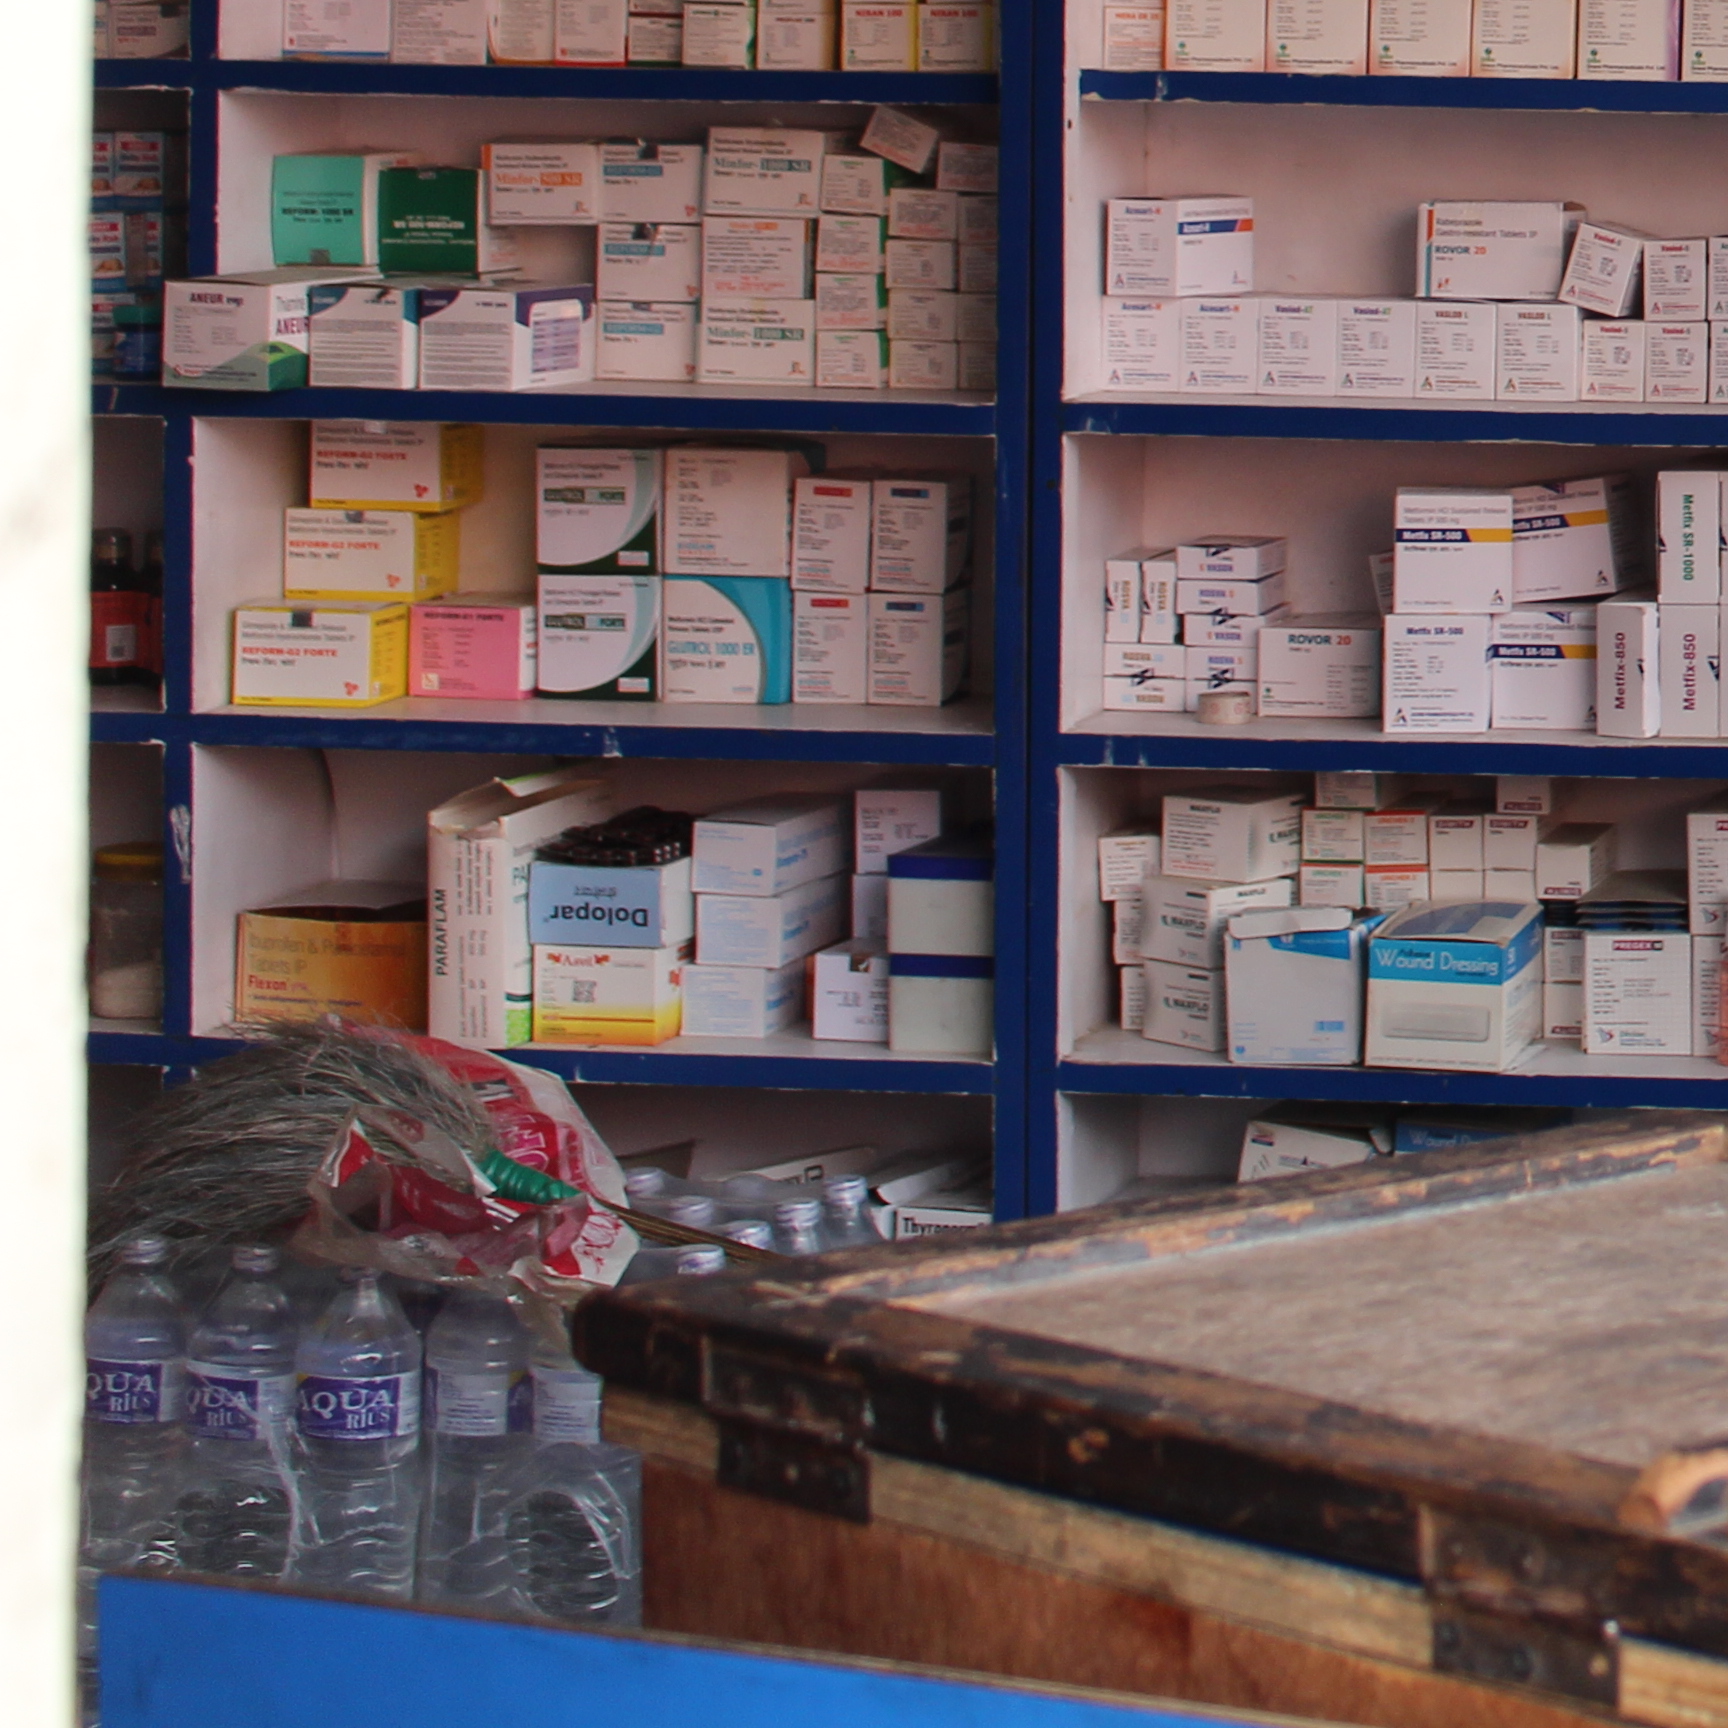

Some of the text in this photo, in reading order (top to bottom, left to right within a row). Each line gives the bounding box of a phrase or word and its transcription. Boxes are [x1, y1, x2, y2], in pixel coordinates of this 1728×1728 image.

[1684, 494, 1695, 582] Metfix SR-1000
[1614, 632, 1626, 710] Metfix-850
[434, 888, 447, 976] PARAFLAM
[548, 902, 649, 928] Dolopar
[247, 975, 287, 993] Flexon
[1374, 947, 1499, 977] Wound Dressing
